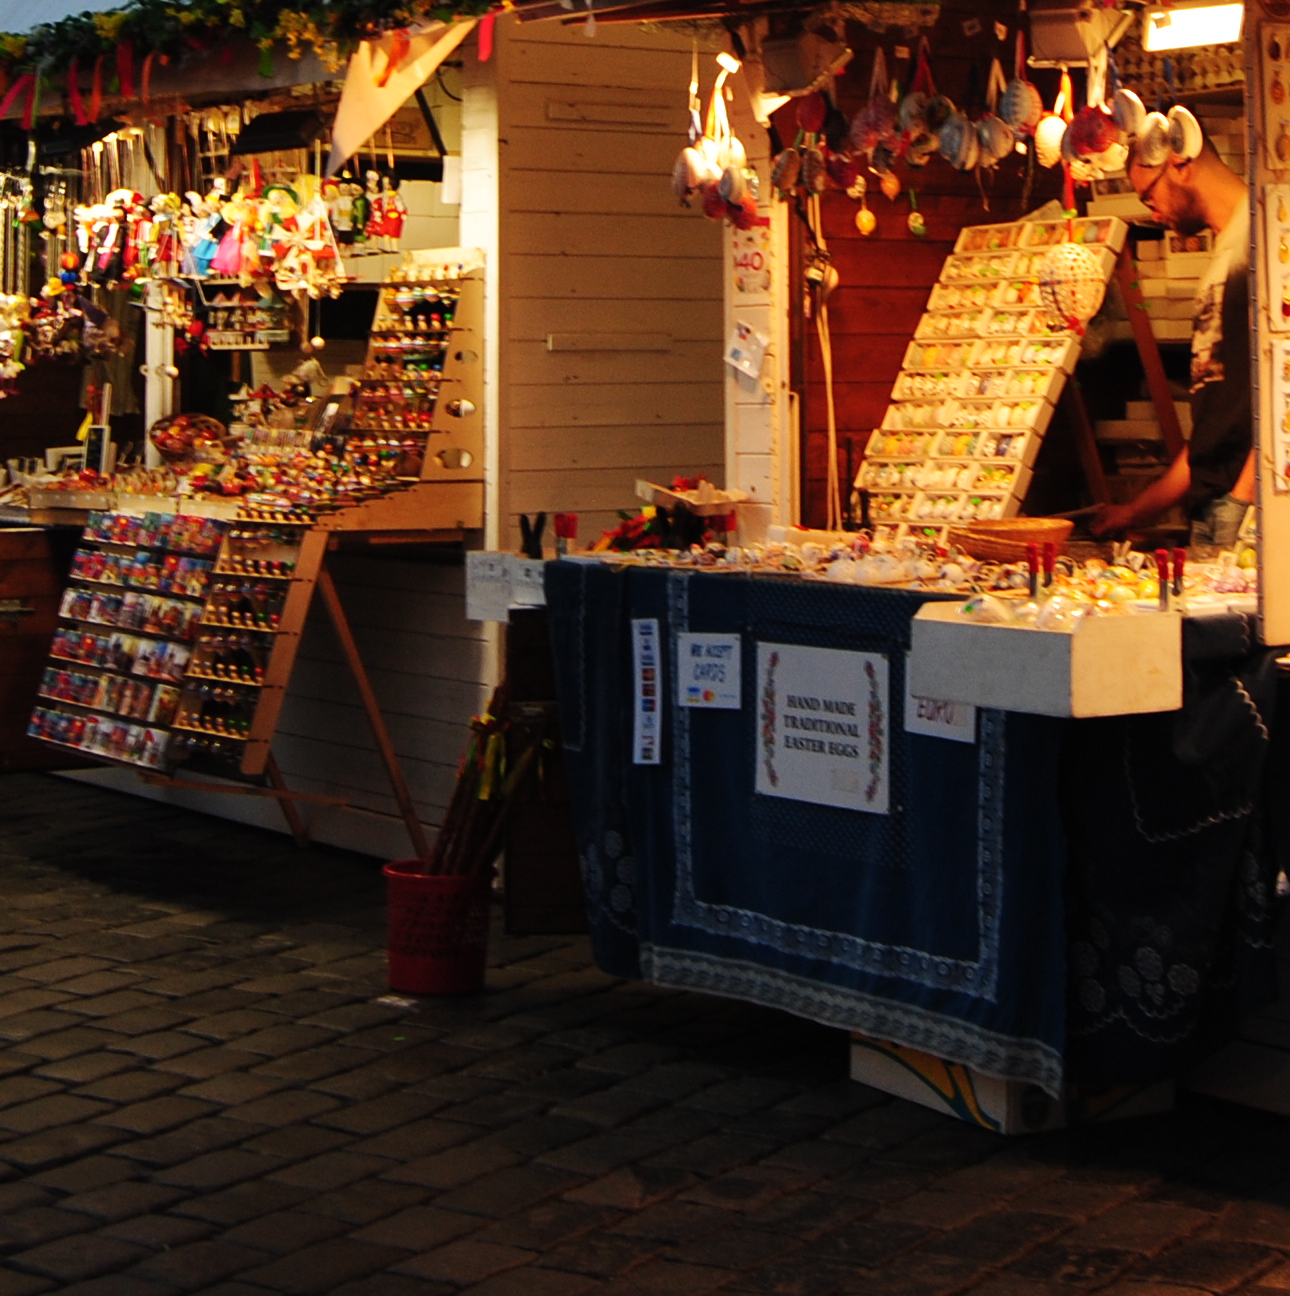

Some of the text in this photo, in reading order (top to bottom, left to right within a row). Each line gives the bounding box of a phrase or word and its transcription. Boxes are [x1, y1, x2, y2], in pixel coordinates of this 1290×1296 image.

[786, 695, 856, 716] HAND MADE
[784, 714, 860, 737] TRADITIONAL
[784, 735, 859, 758] EASTER EGGS
